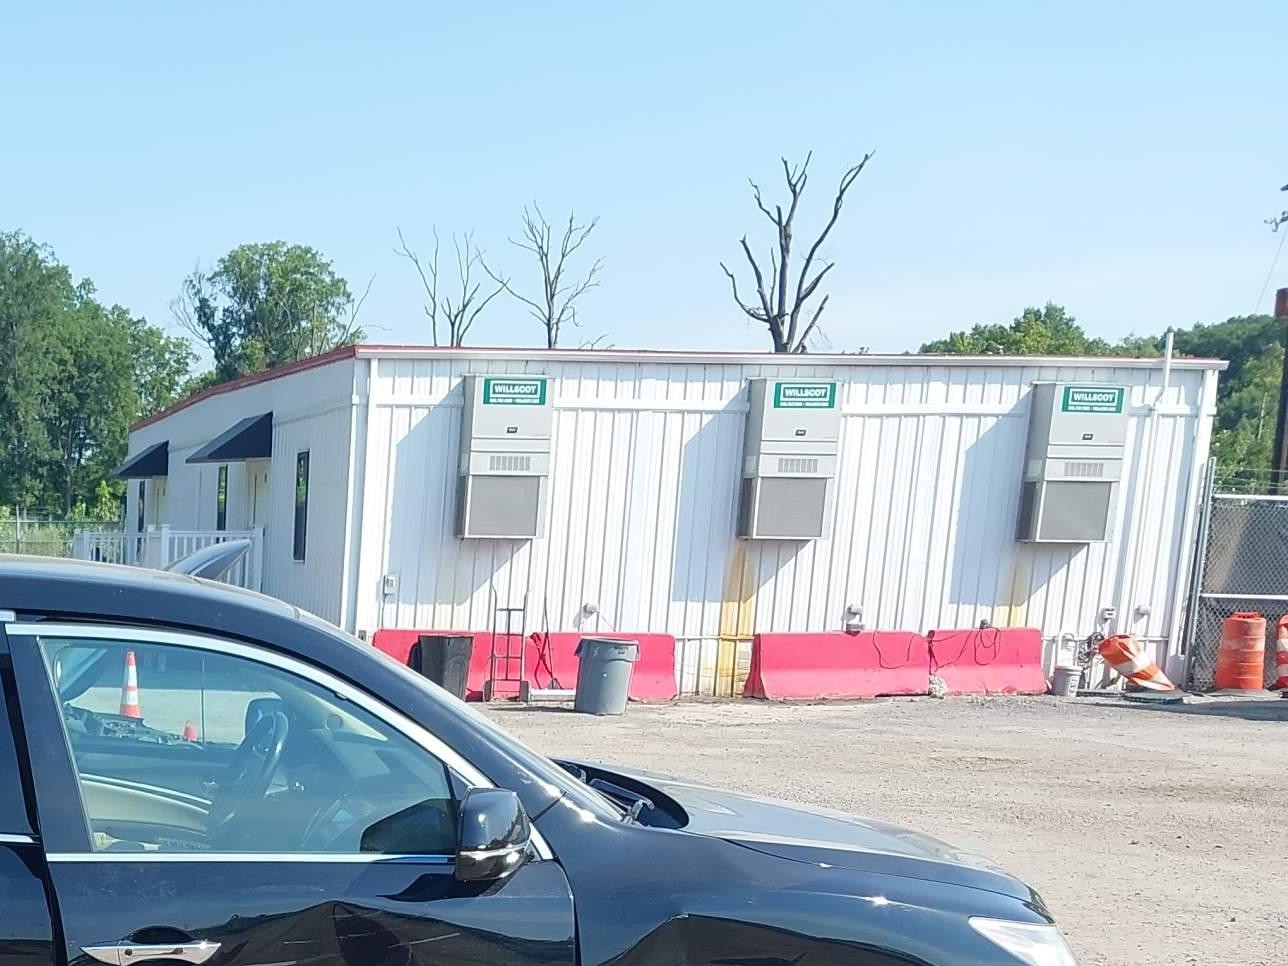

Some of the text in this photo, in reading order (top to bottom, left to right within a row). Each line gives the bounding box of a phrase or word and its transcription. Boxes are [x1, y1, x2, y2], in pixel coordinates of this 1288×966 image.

[494, 385, 536, 394] WILLSCOT
[784, 389, 826, 397] WILLSCOT
[1073, 393, 1114, 402] WILLSCOT
